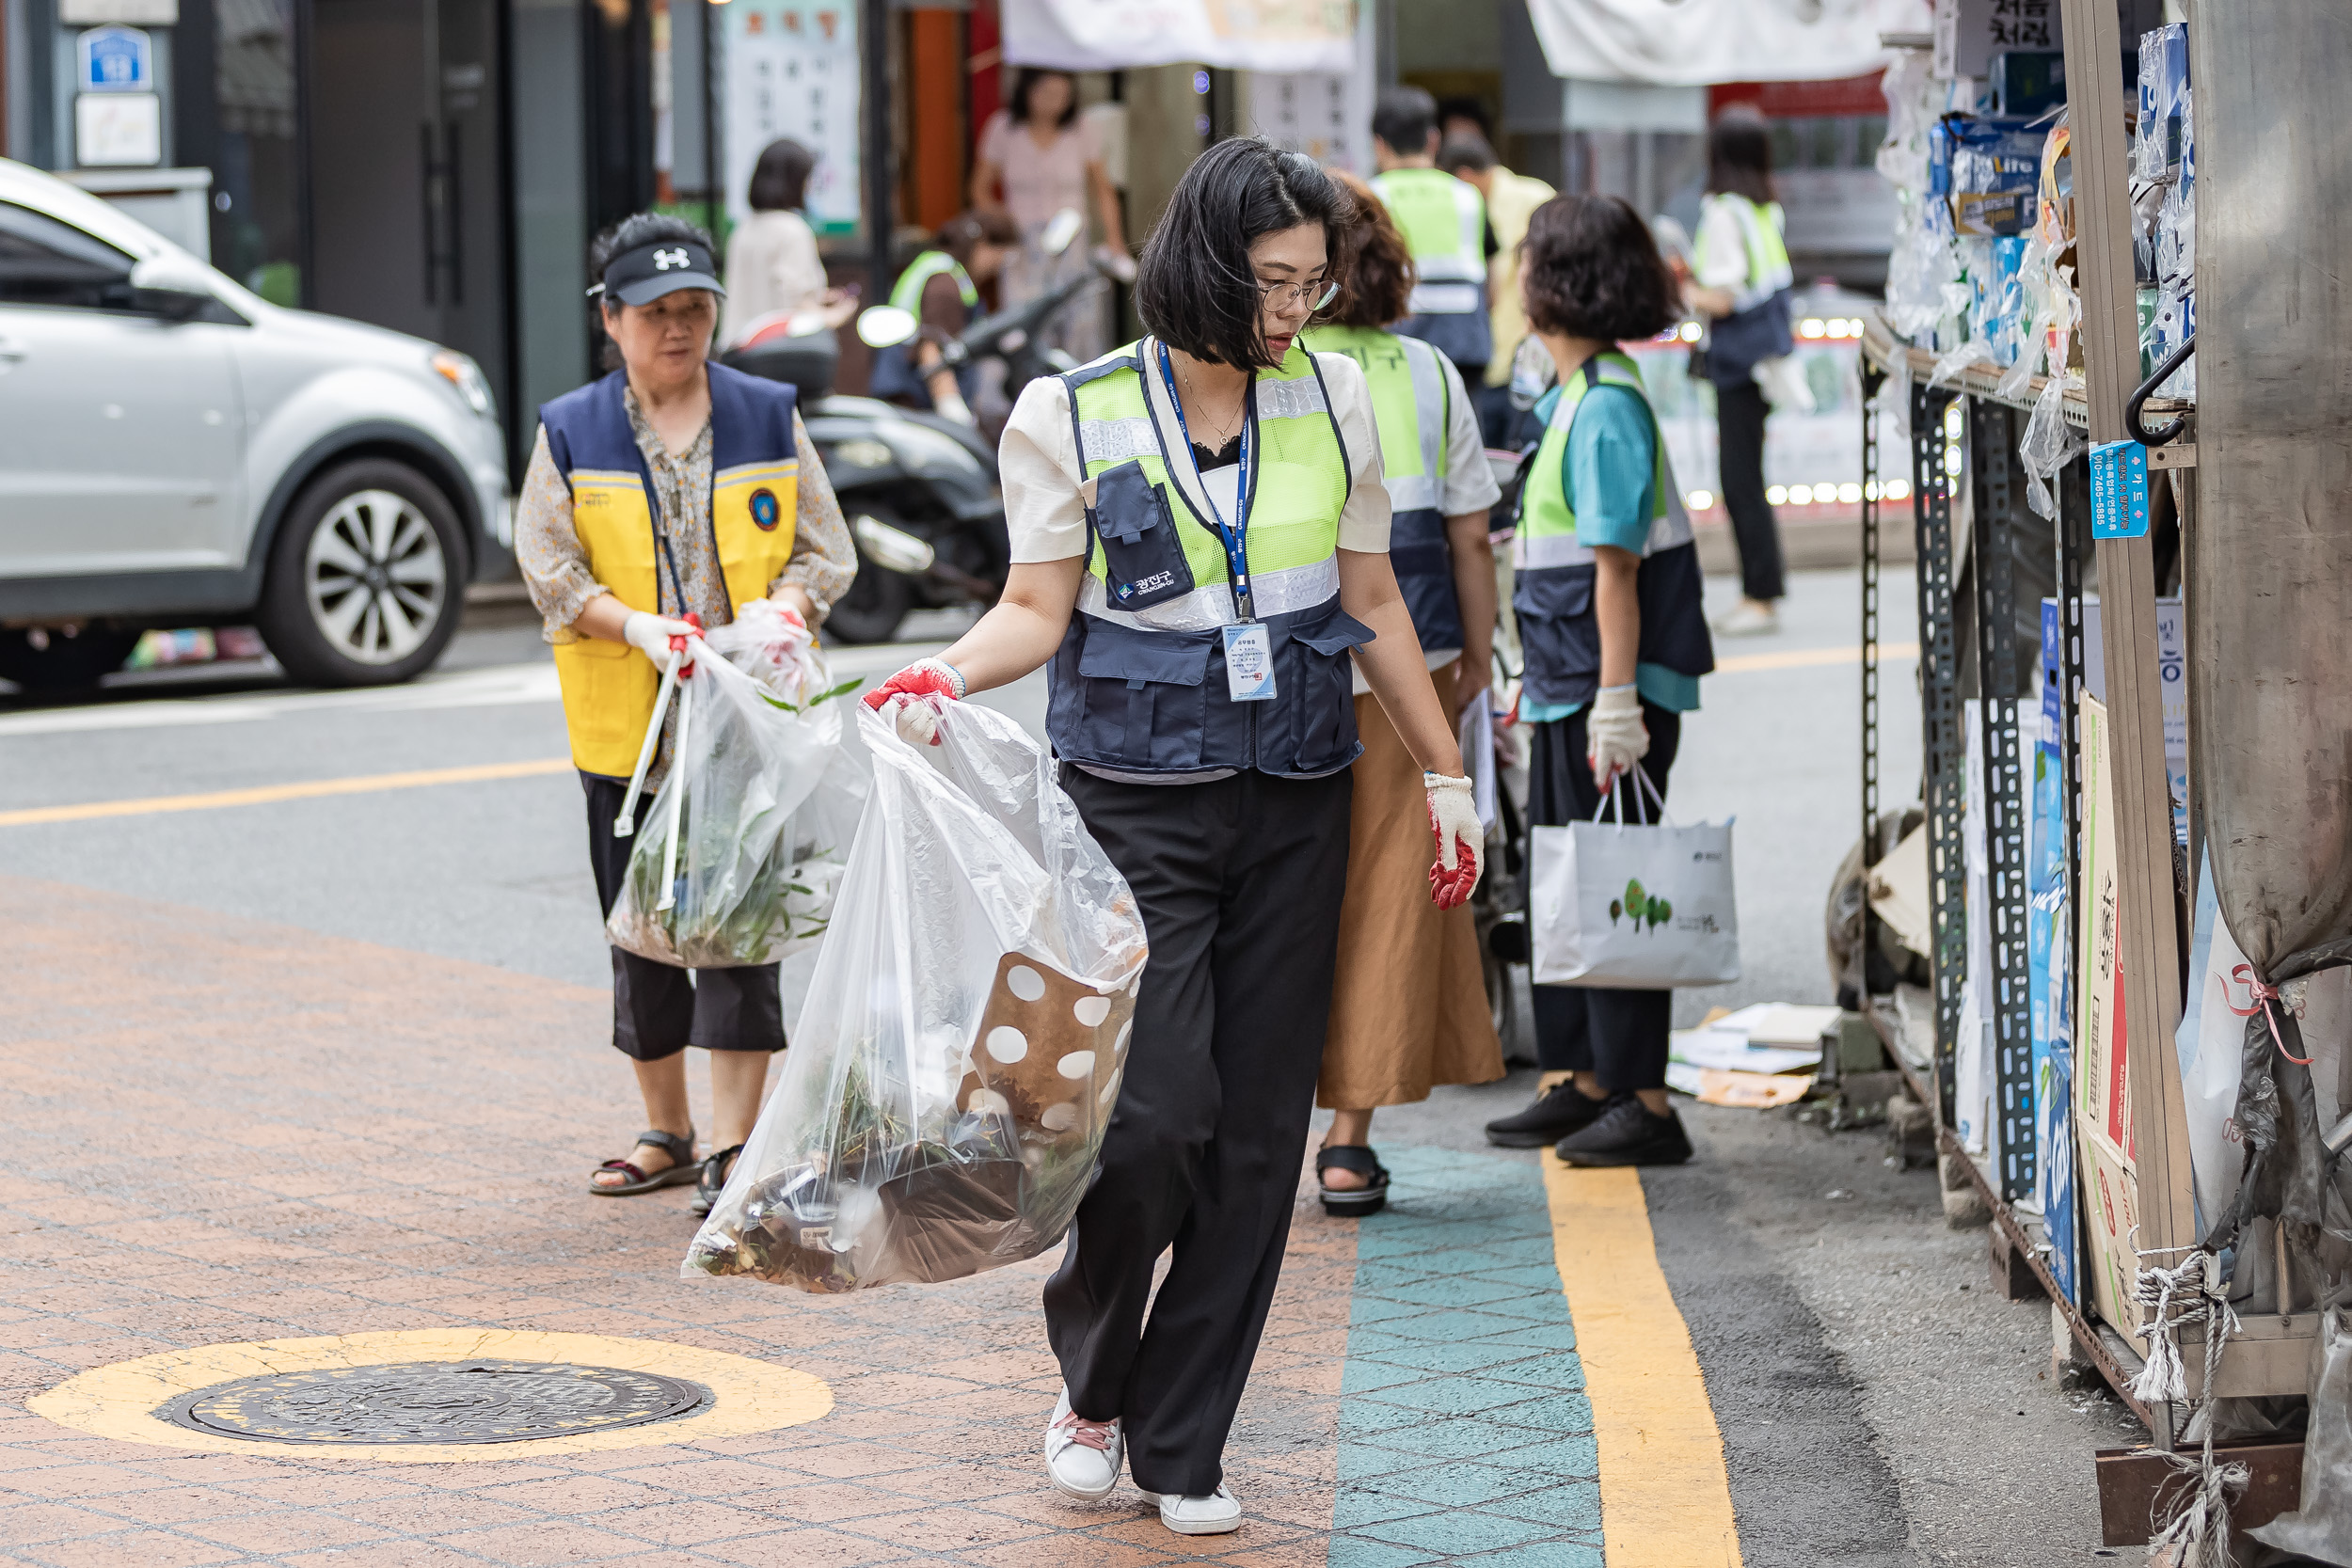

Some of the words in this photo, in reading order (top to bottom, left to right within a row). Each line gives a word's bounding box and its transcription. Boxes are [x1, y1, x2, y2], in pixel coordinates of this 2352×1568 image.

[2093, 454, 2106, 525] 010-7465-5885
[1136, 570, 1172, 590] 광진구
[1137, 578, 1175, 595] GWANGJIN-GU
